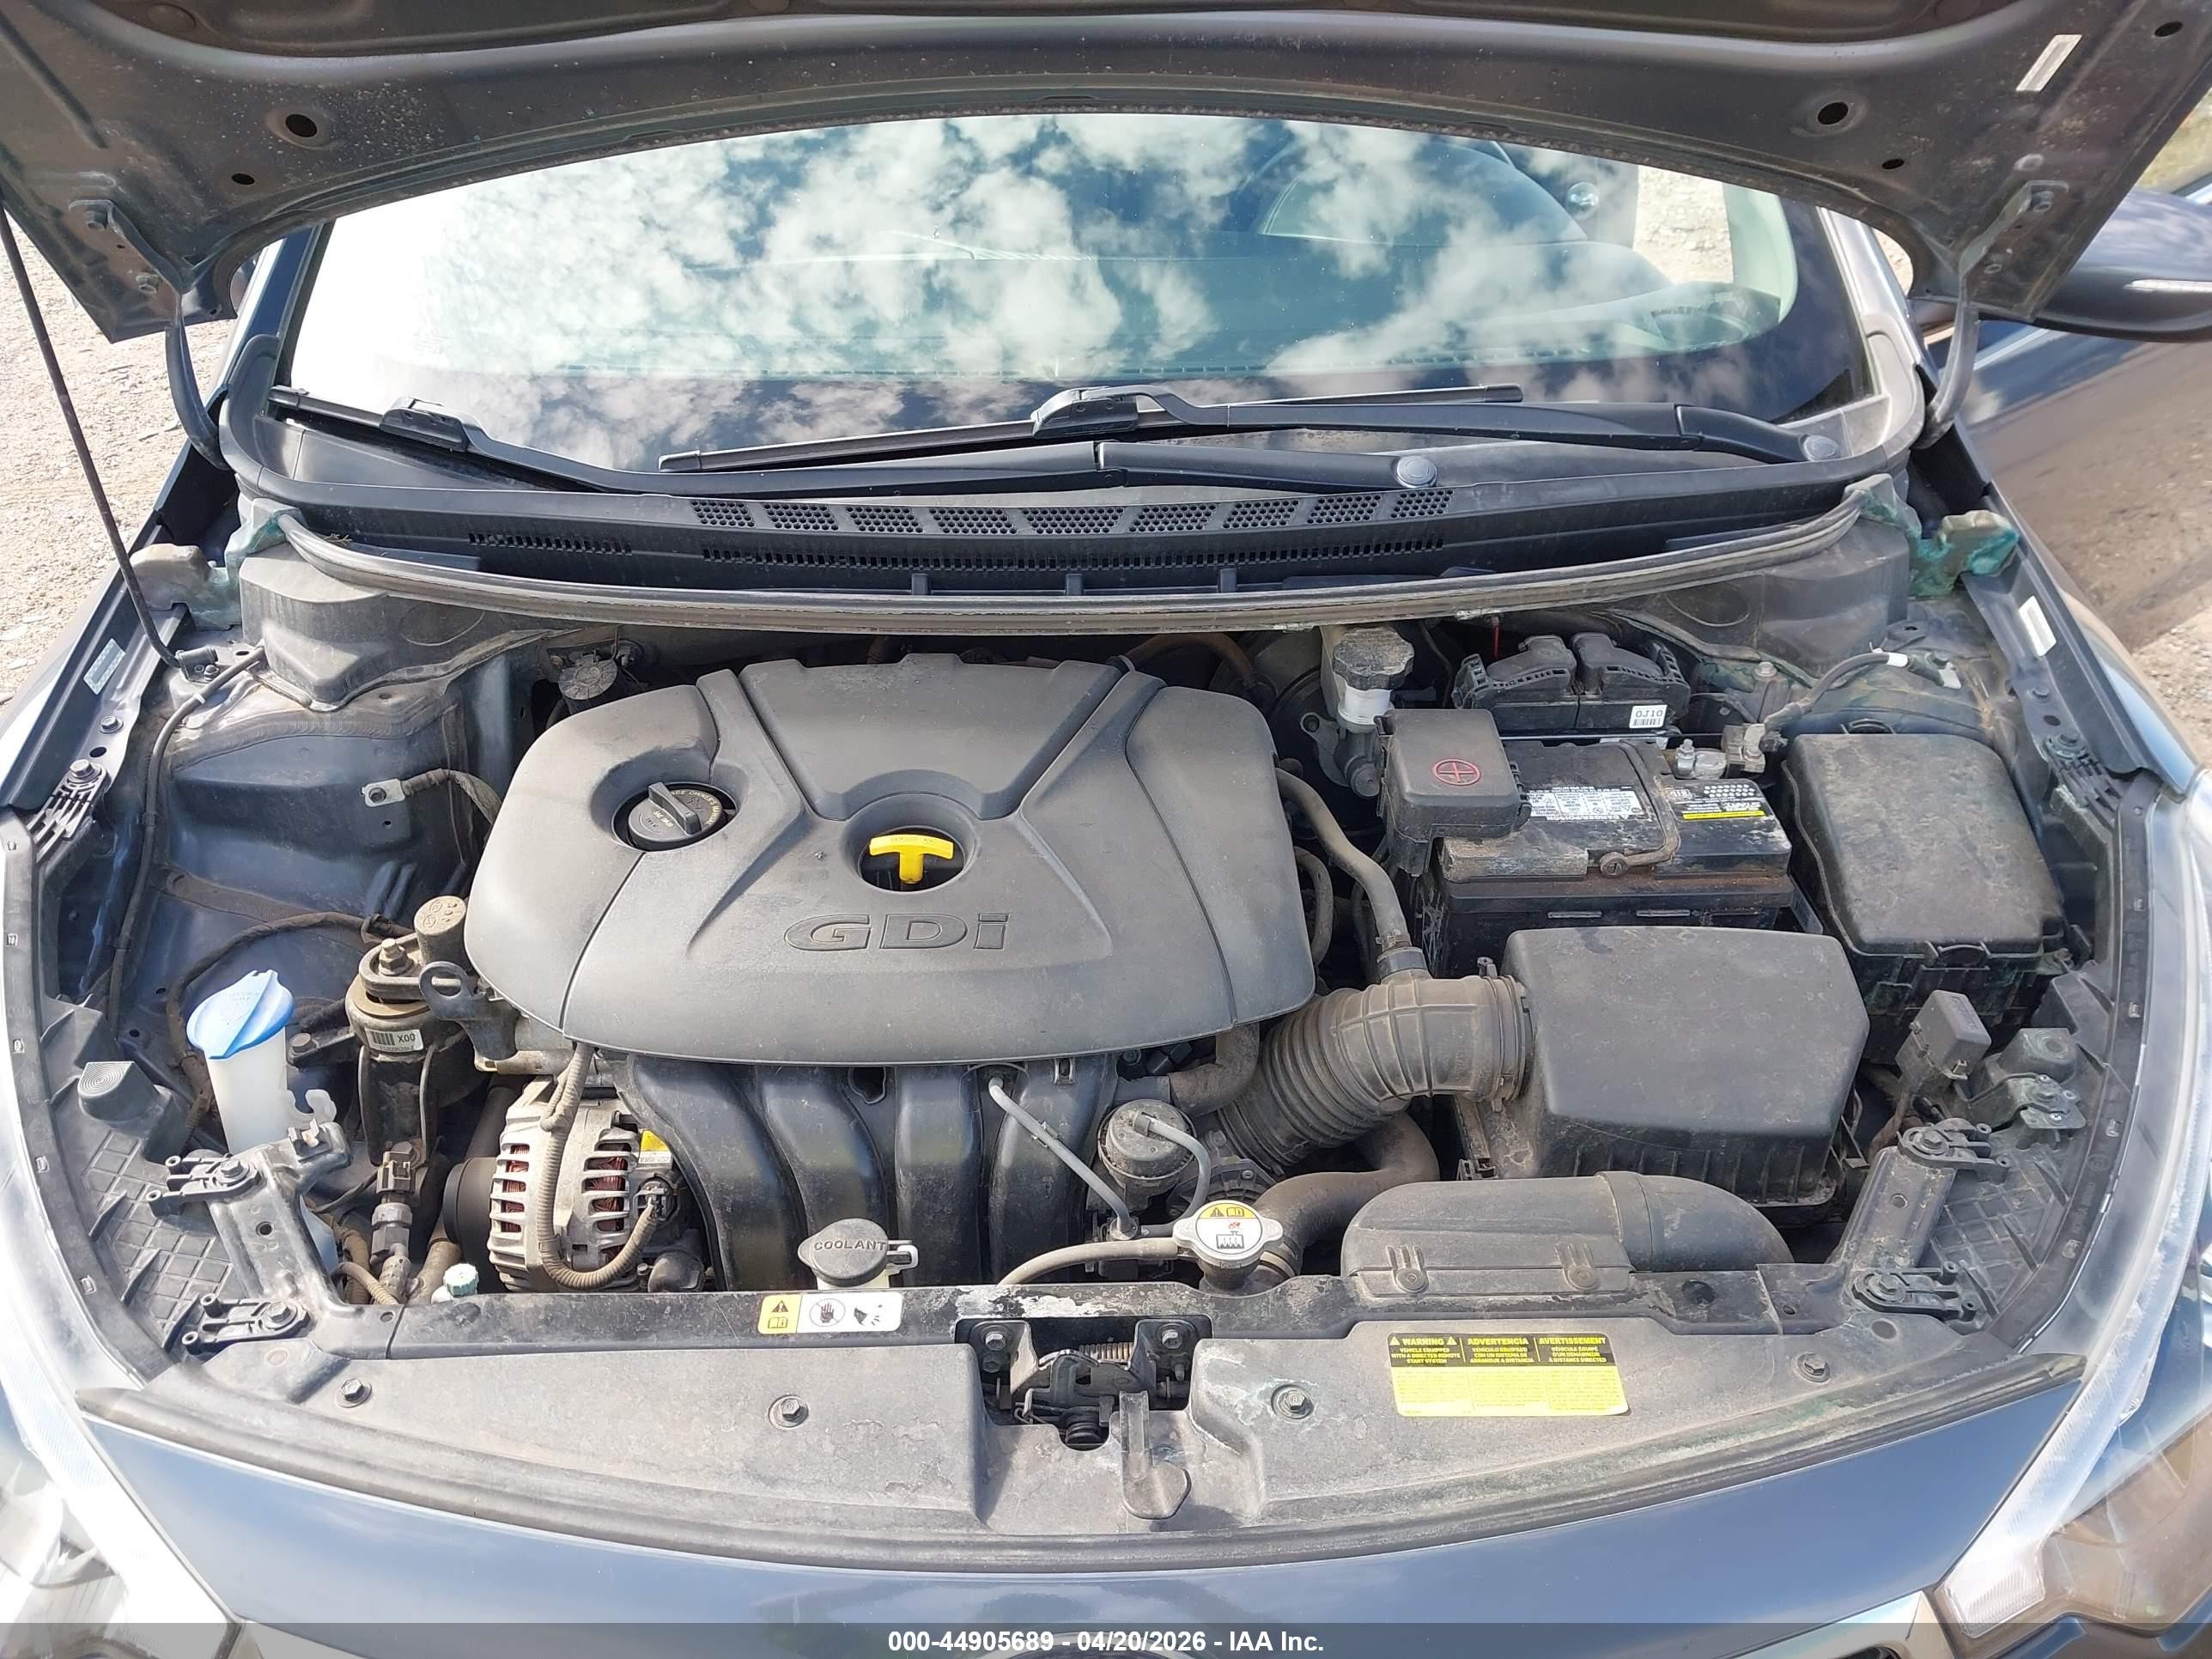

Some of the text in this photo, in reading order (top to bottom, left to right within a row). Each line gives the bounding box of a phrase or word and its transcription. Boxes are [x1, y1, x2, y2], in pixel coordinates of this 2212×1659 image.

[783, 913, 1011, 952] GDi
[398, 1033, 416, 1042] X00
[814, 1240, 887, 1251] COOLANT
[1468, 1337, 1529, 1346] ADVERTENCIA
